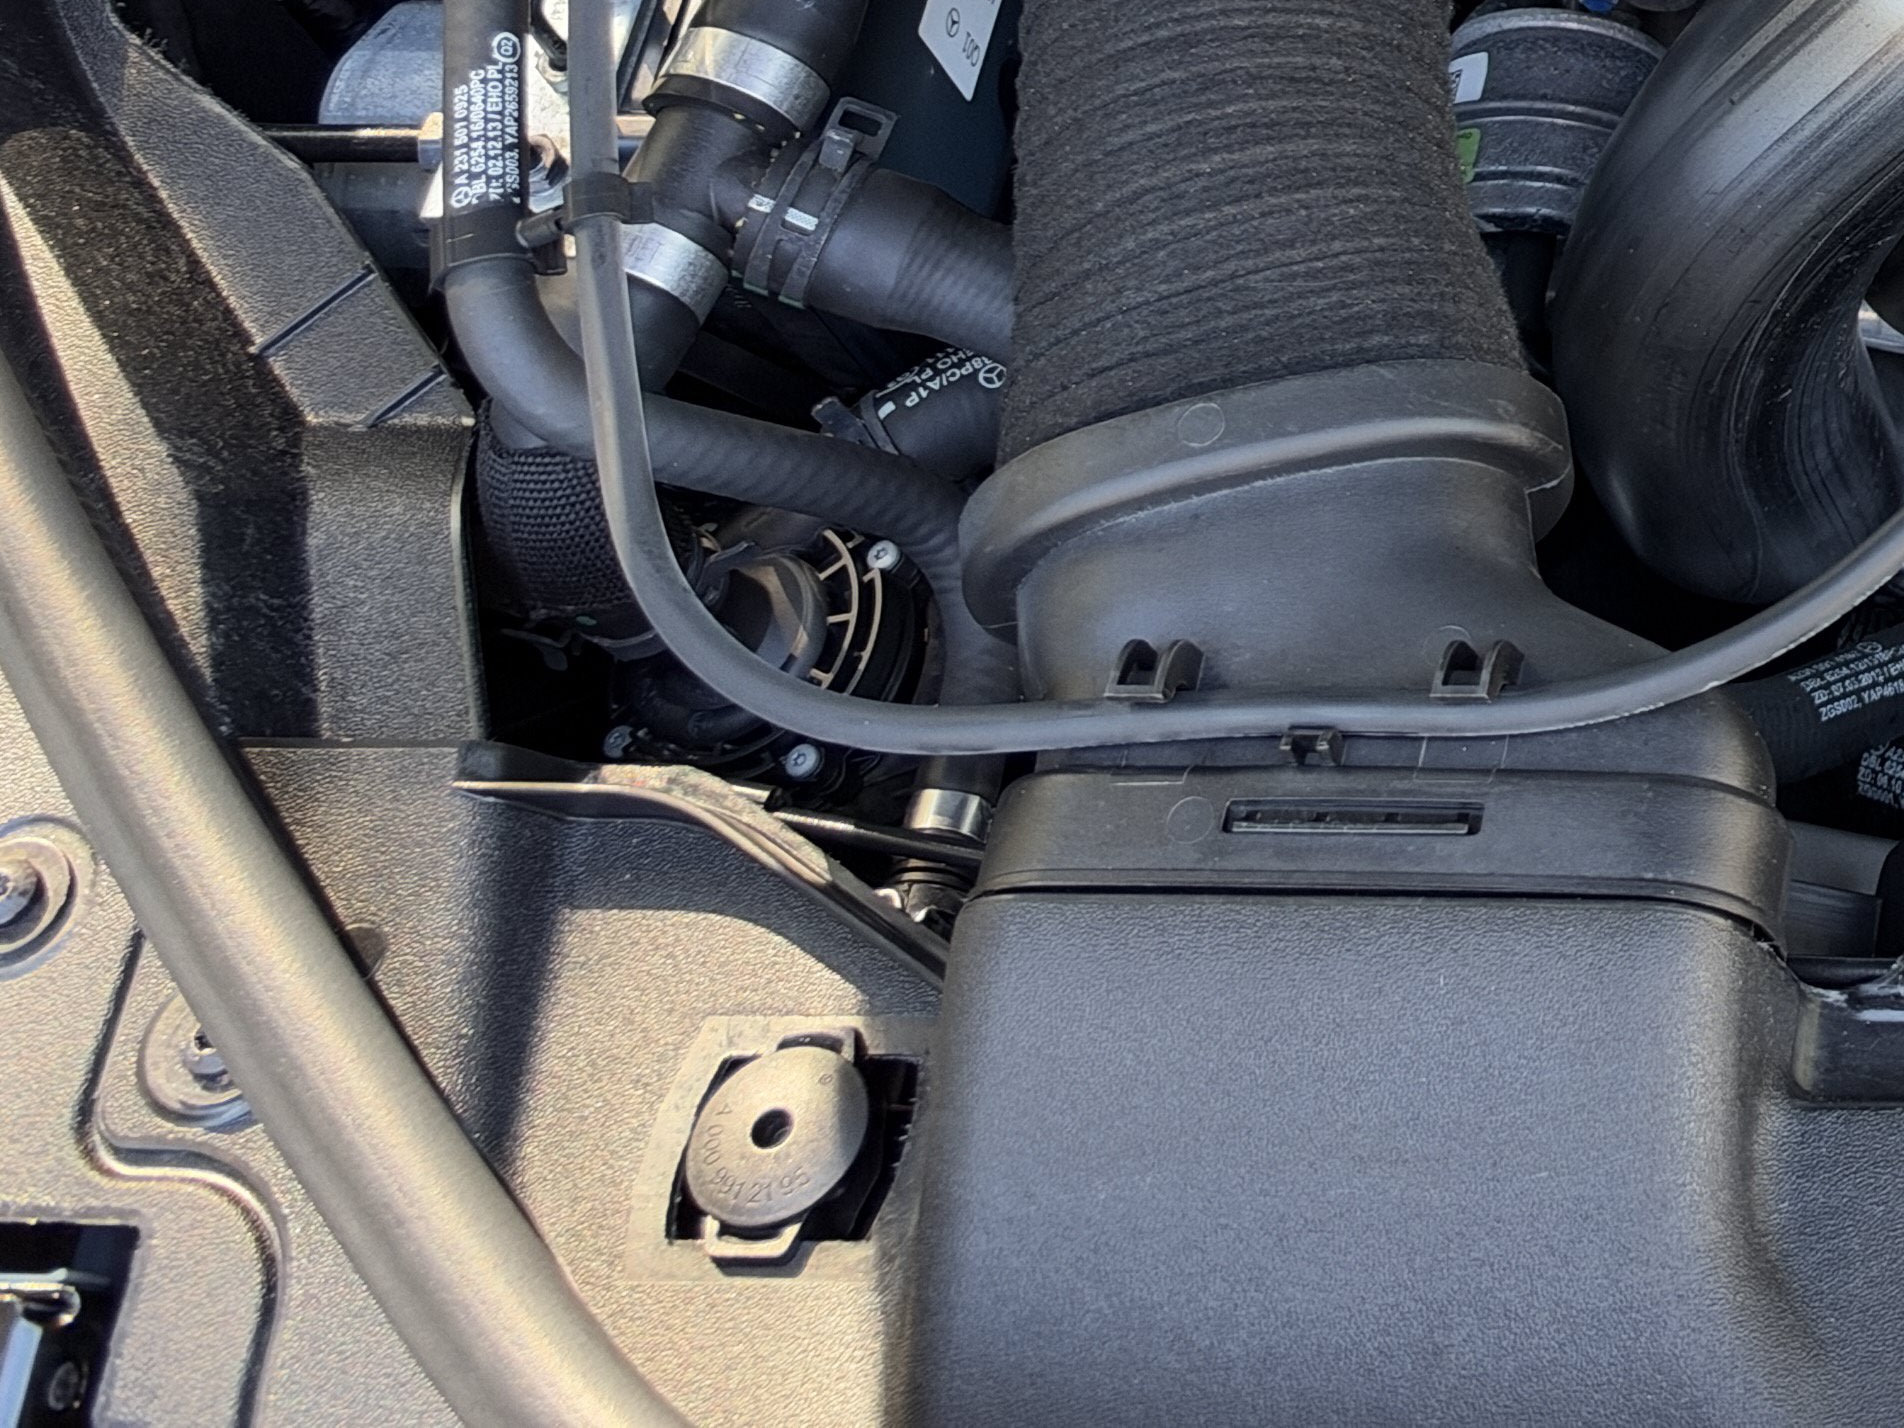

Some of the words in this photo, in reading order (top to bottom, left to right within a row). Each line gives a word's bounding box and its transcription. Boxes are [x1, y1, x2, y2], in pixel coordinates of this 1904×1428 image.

[488, 61, 502, 78] PL
[454, 84, 468, 116] 0925
[488, 80, 502, 110] EHO
[453, 122, 468, 142] 501
[453, 147, 468, 170] 231
